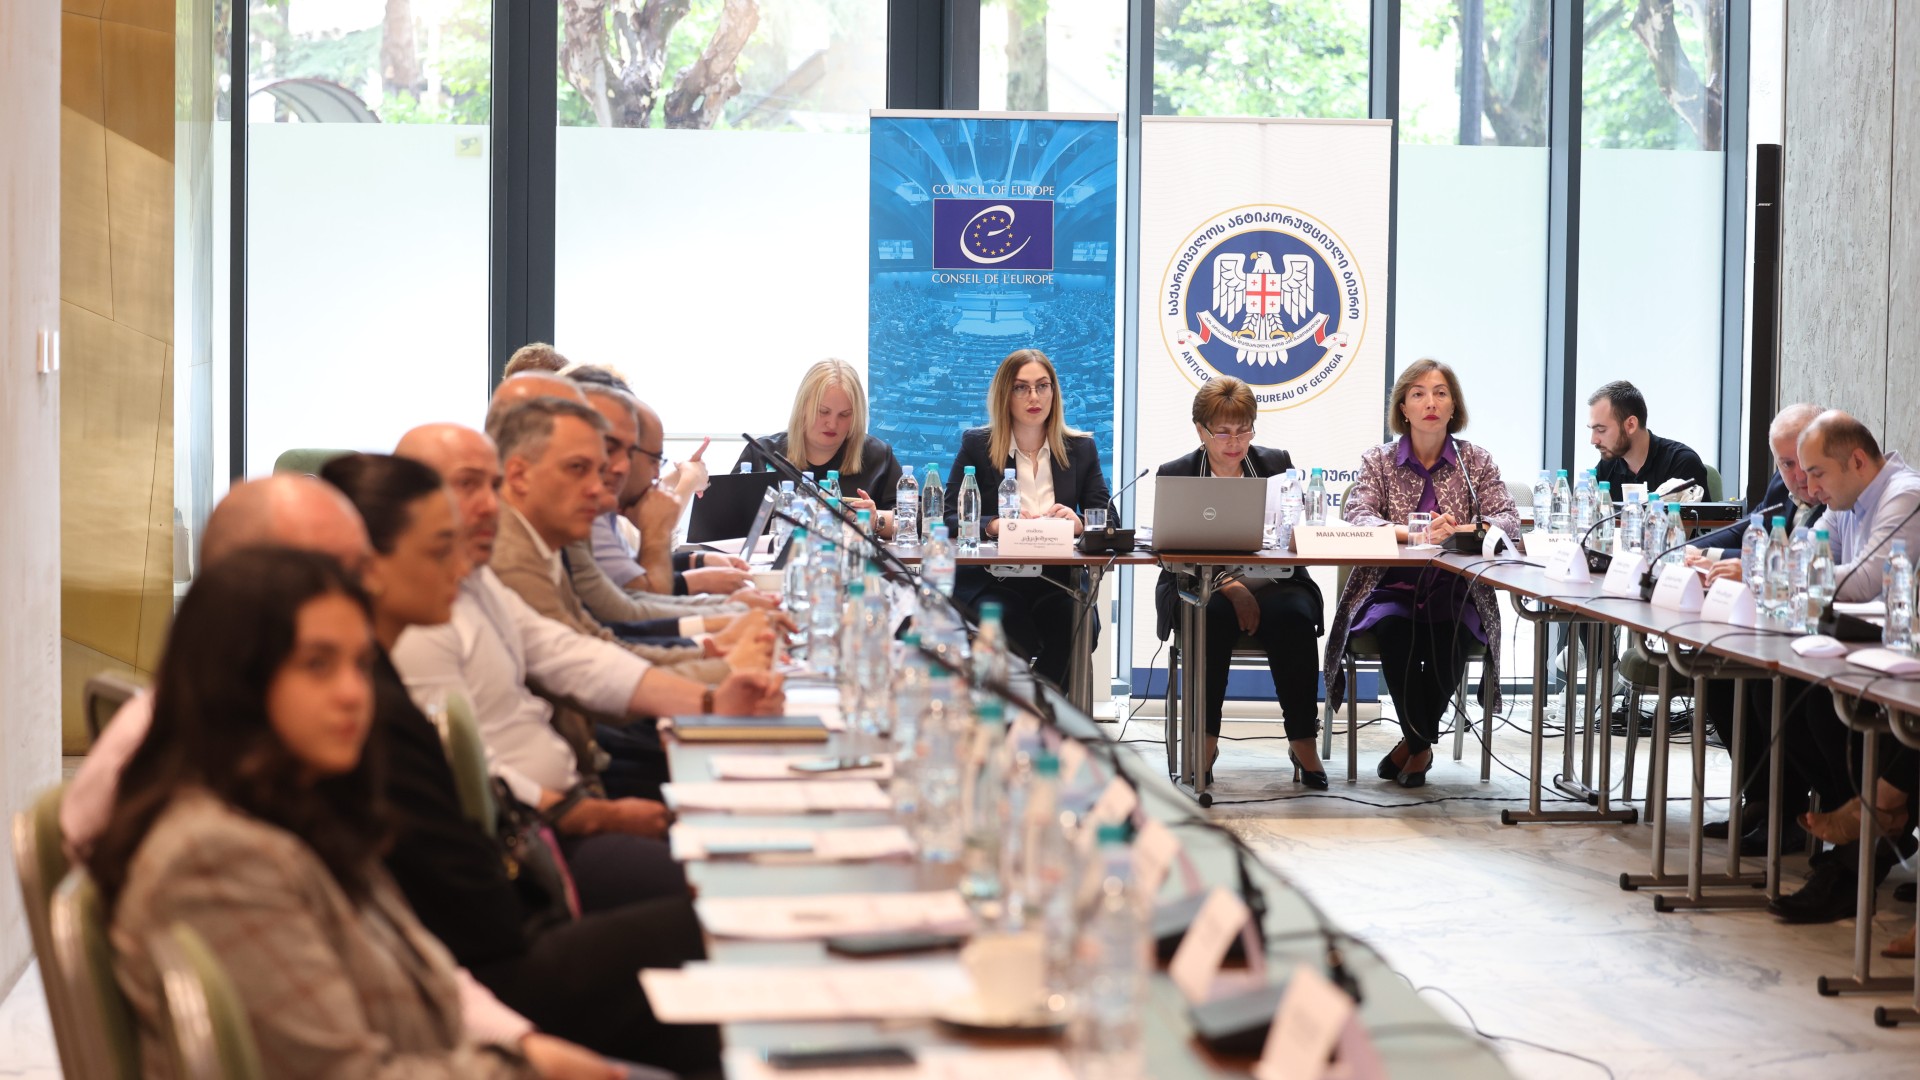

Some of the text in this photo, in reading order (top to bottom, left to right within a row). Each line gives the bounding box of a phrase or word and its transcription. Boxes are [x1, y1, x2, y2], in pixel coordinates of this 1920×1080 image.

[932, 184, 1055, 196] COUNCIL OF EUROPE
[931, 273, 983, 284] CONSEIL
[984, 274, 999, 284] DE
[1168, 211, 1360, 320] საქართველოს ანტიკორუფციული ბიურო
[1256, 390, 1295, 403] BUREAU
[1296, 383, 1309, 395] OF
[1309, 353, 1343, 388] GEORGIA
